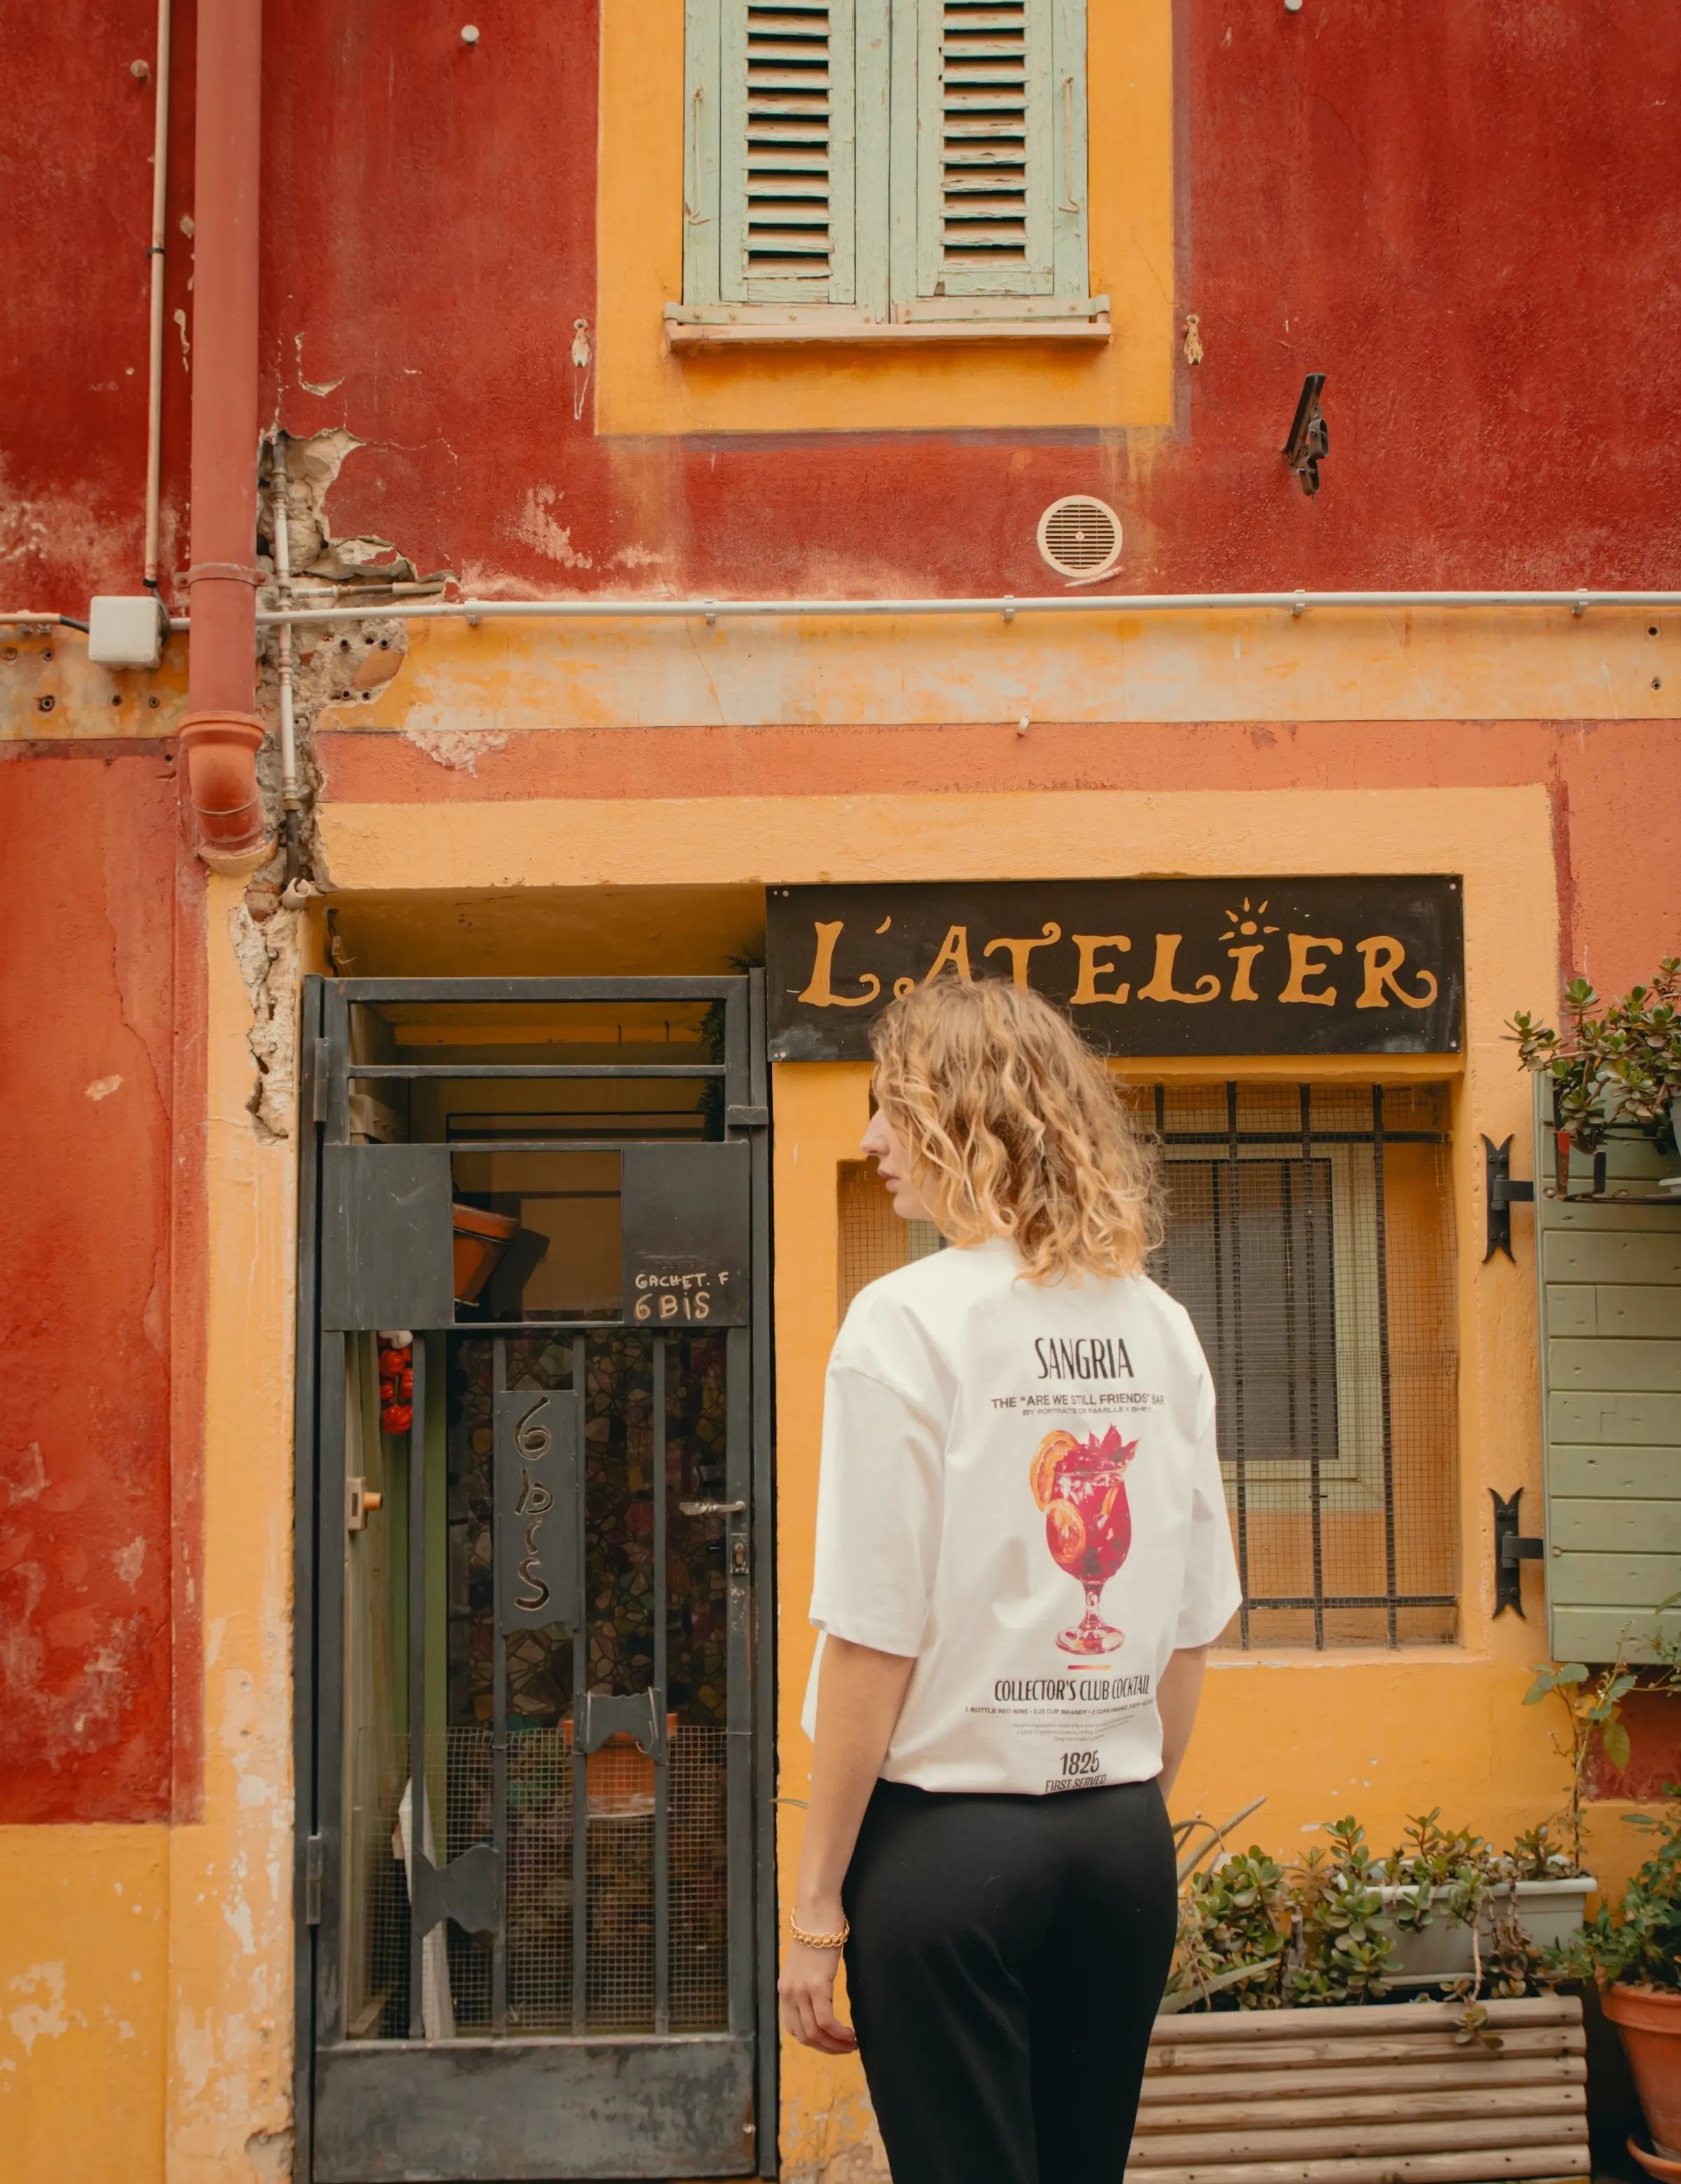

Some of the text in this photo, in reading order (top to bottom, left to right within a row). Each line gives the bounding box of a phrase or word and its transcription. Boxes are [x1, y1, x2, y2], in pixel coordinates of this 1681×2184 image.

[718, 1271, 729, 1286] F
[1035, 1337, 1135, 1379] SANGRIA
[990, 1397, 1017, 1409] THE
[1052, 1395, 1068, 1405] WE
[1071, 1395, 1097, 1405] STILL
[1151, 1395, 1165, 1405] BAR
[995, 1674, 1151, 1702] COLLECTOR'S CLUB COCKTAIL
[1060, 1749, 1100, 1775] 1825
[1045, 1774, 1107, 1793] FIRST SERVED
